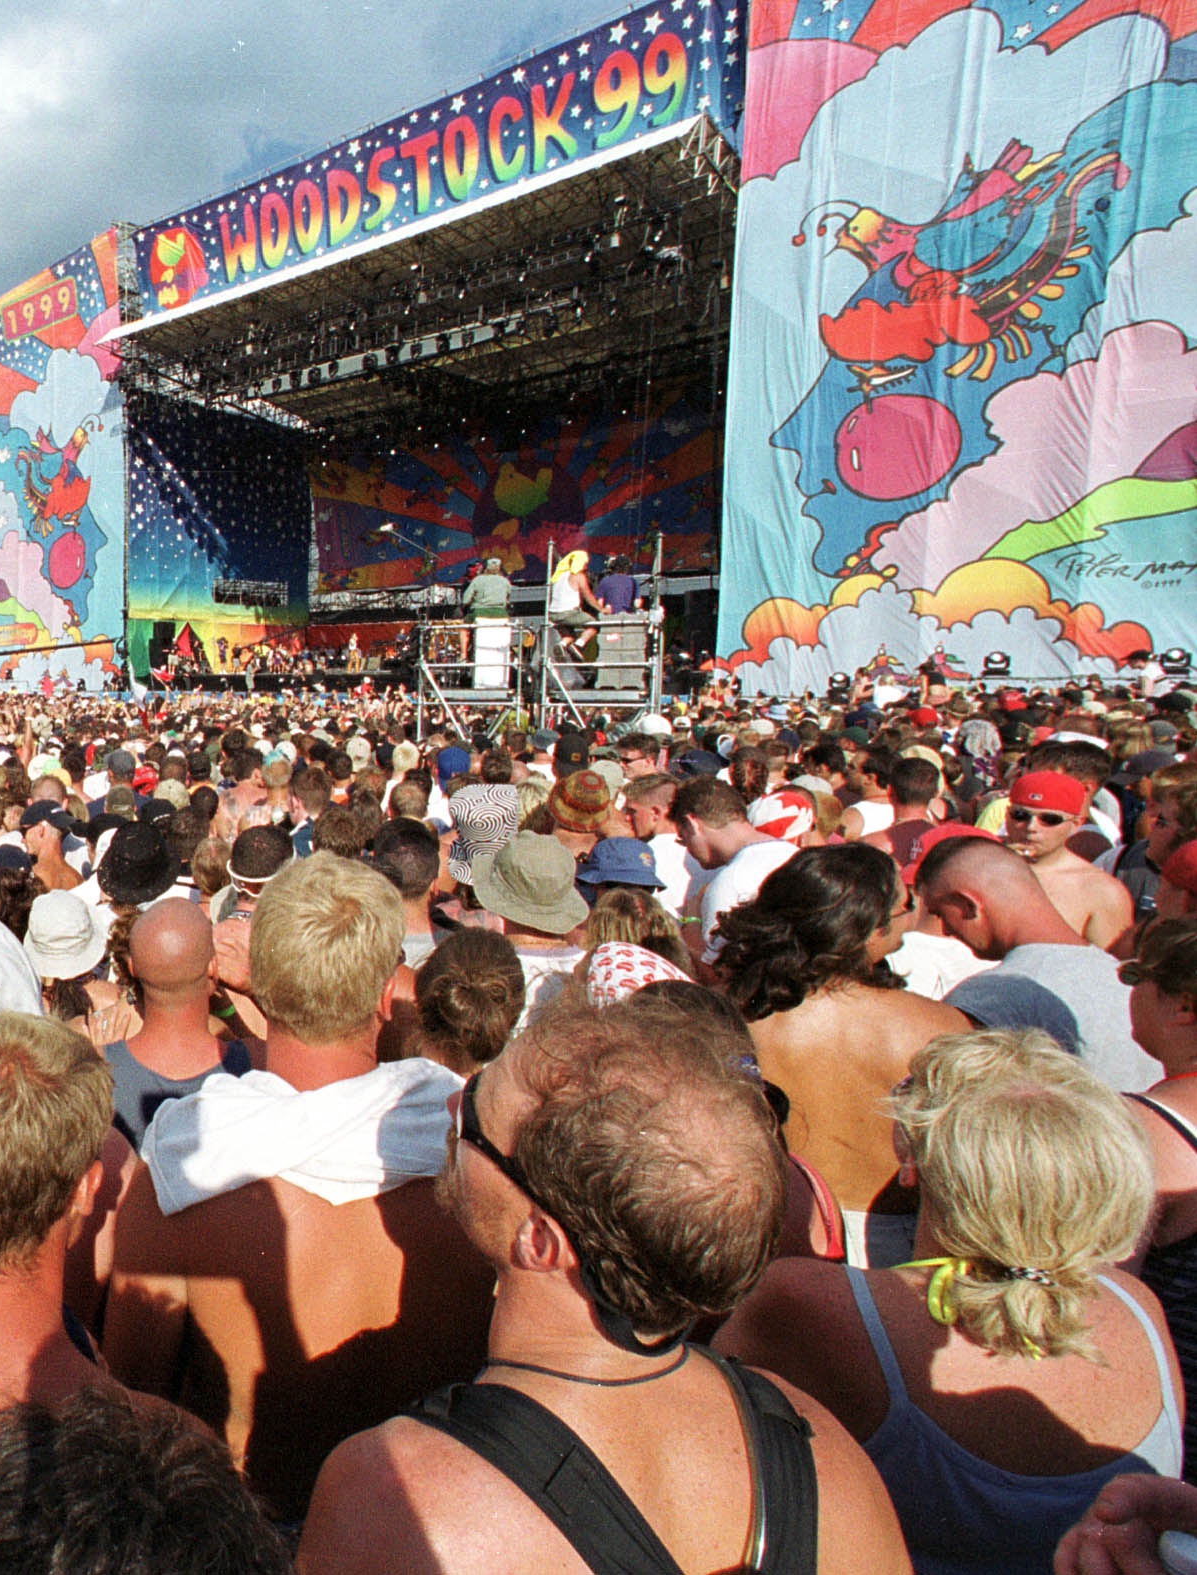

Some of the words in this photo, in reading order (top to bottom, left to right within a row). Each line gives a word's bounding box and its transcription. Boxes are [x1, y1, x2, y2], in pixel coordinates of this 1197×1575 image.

[218, 71, 579, 284] WOODSTOCK
[592, 32, 688, 149] 99
[7, 285, 71, 335] 1999
